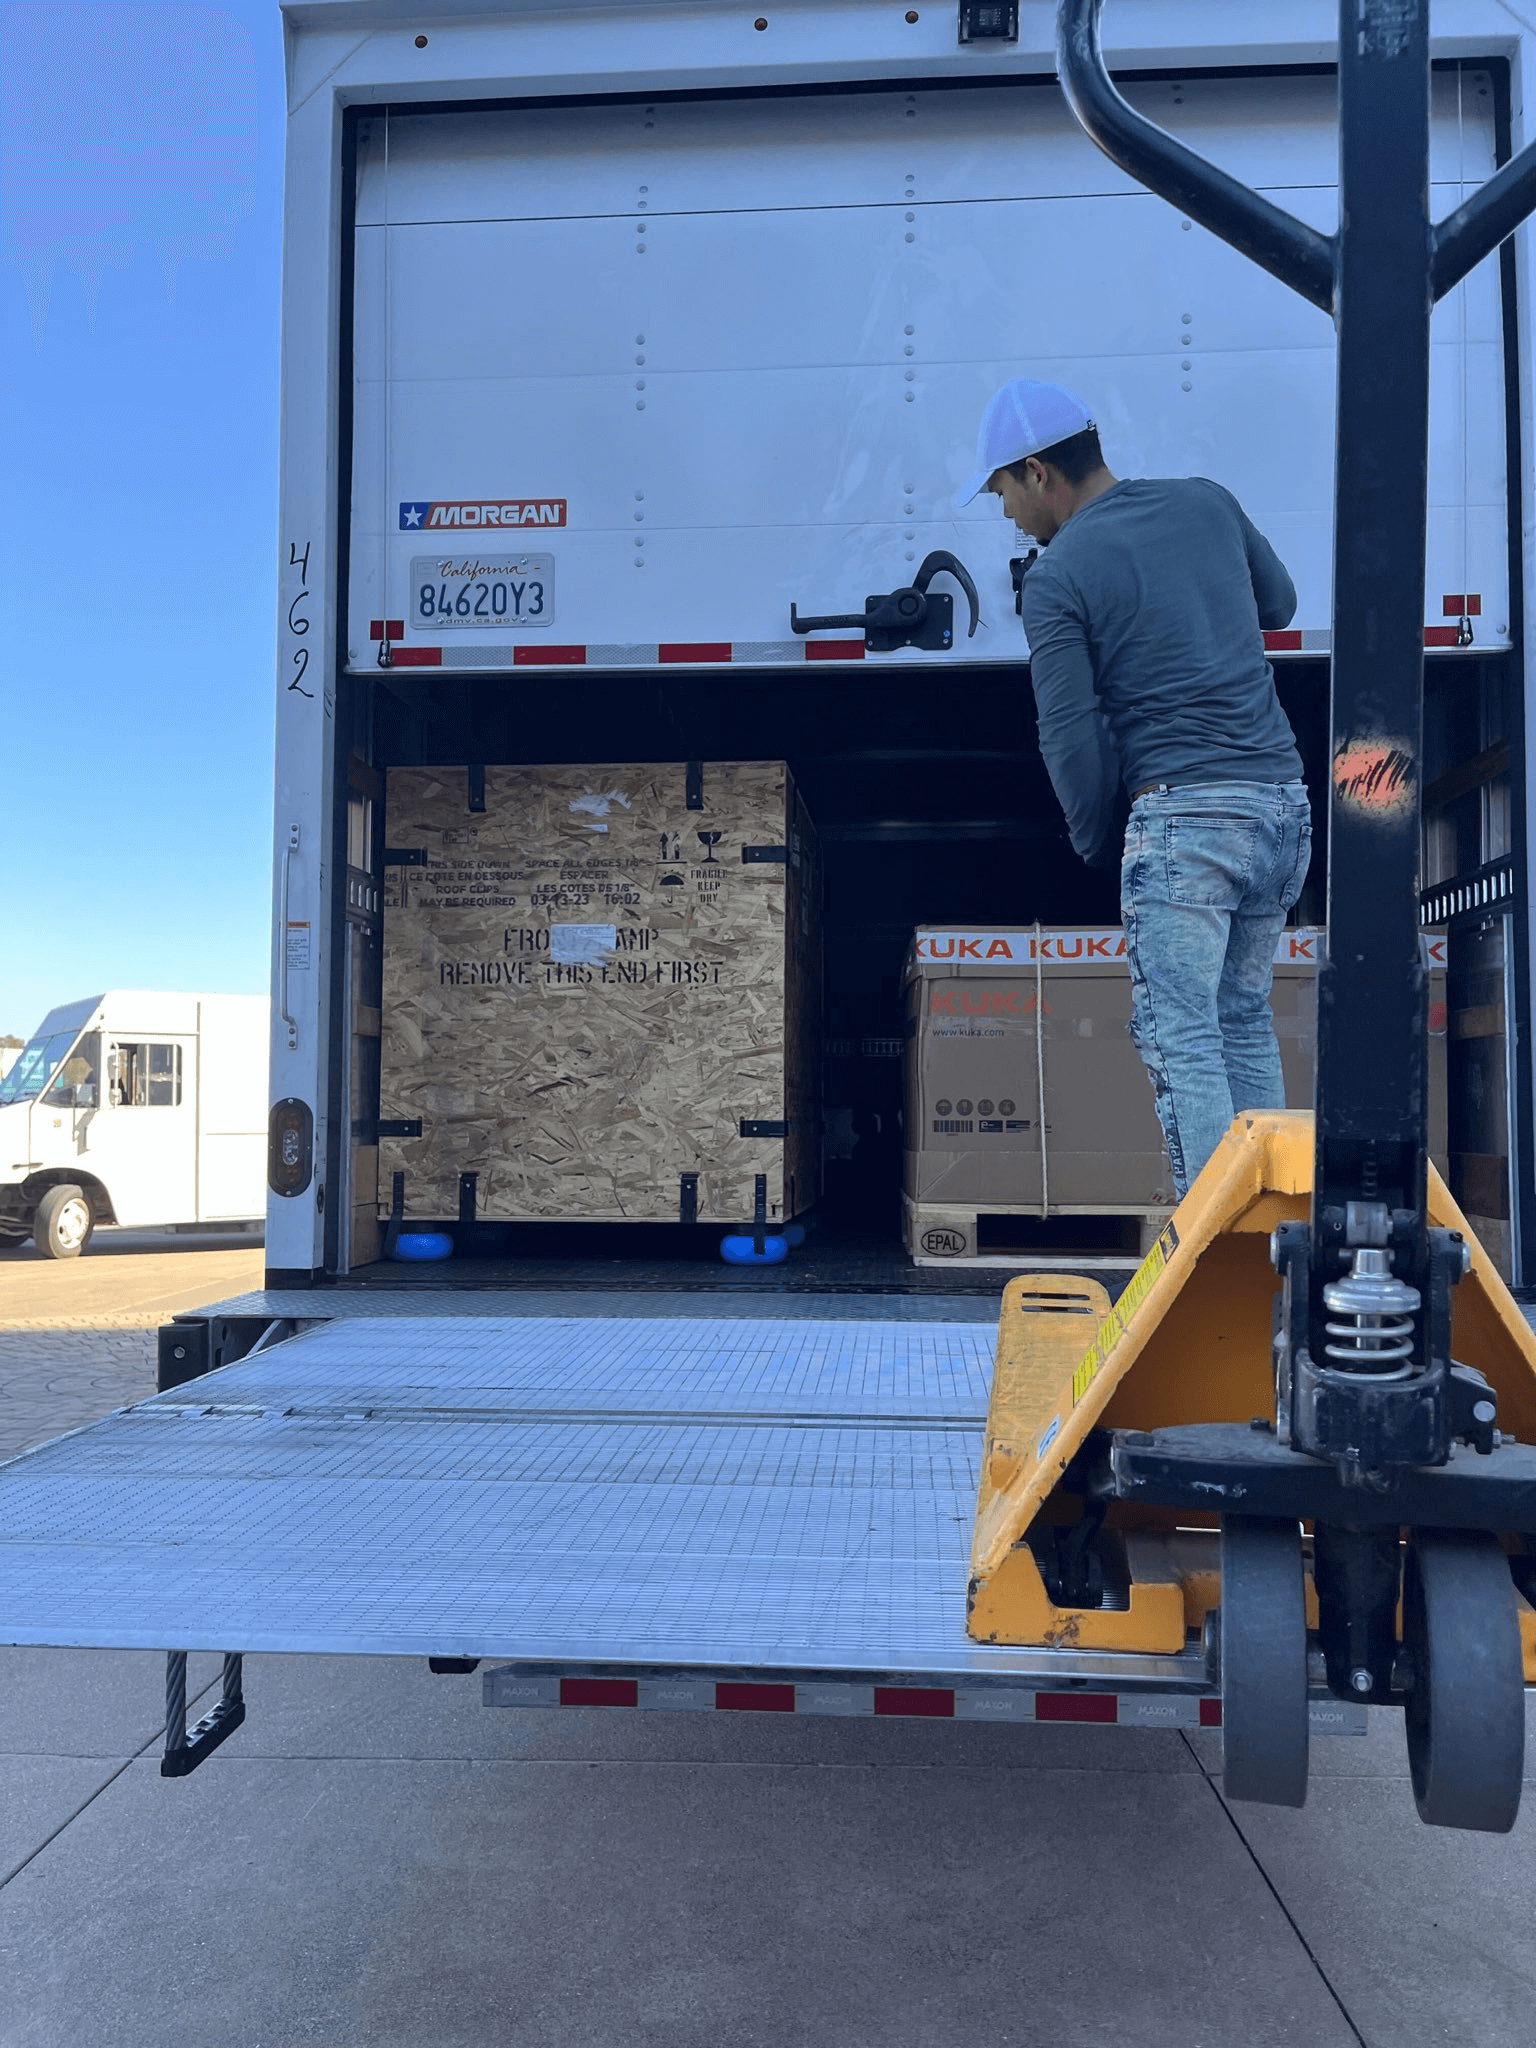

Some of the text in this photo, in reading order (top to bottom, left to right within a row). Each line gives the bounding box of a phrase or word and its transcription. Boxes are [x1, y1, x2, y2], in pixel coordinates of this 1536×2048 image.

[429, 504, 559, 526] MORGAN
[440, 559, 528, 582] California
[419, 581, 544, 617] 84620Y3
[444, 616, 520, 625] dmv.ca.gov
[451, 860, 476, 869] SIDE
[525, 860, 560, 868] SPACE
[562, 859, 582, 868] ALL
[586, 859, 621, 868] EDGES
[409, 872, 525, 881] CE COTE EN DESSOUS
[560, 871, 609, 880] ESPACER
[691, 869, 728, 879] FRAGILE
[436, 885, 500, 894] ROOF CLIPS
[537, 884, 557, 893] LES
[560, 884, 596, 893] COTES
[598, 884, 613, 892] DE
[697, 881, 721, 891] KEEP
[419, 897, 516, 907] MAY BE REQUIRED
[530, 892, 641, 905] 03-13-23 16:02
[700, 893, 718, 903] DRY
[615, 928, 660, 951] AMP
[440, 961, 724, 985] REMOVE THIS END FIRST
[931, 990, 1053, 1015] KUKA
[932, 1027, 1005, 1038] www.kuka.com
[927, 1234, 960, 1251] EPAL
[502, 1687, 540, 1698] MAXON
[657, 1690, 694, 1701] MAXON
[814, 1695, 852, 1706] MAXON
[975, 1699, 1013, 1711] MAXON
[1138, 1705, 1177, 1717] MAXON
